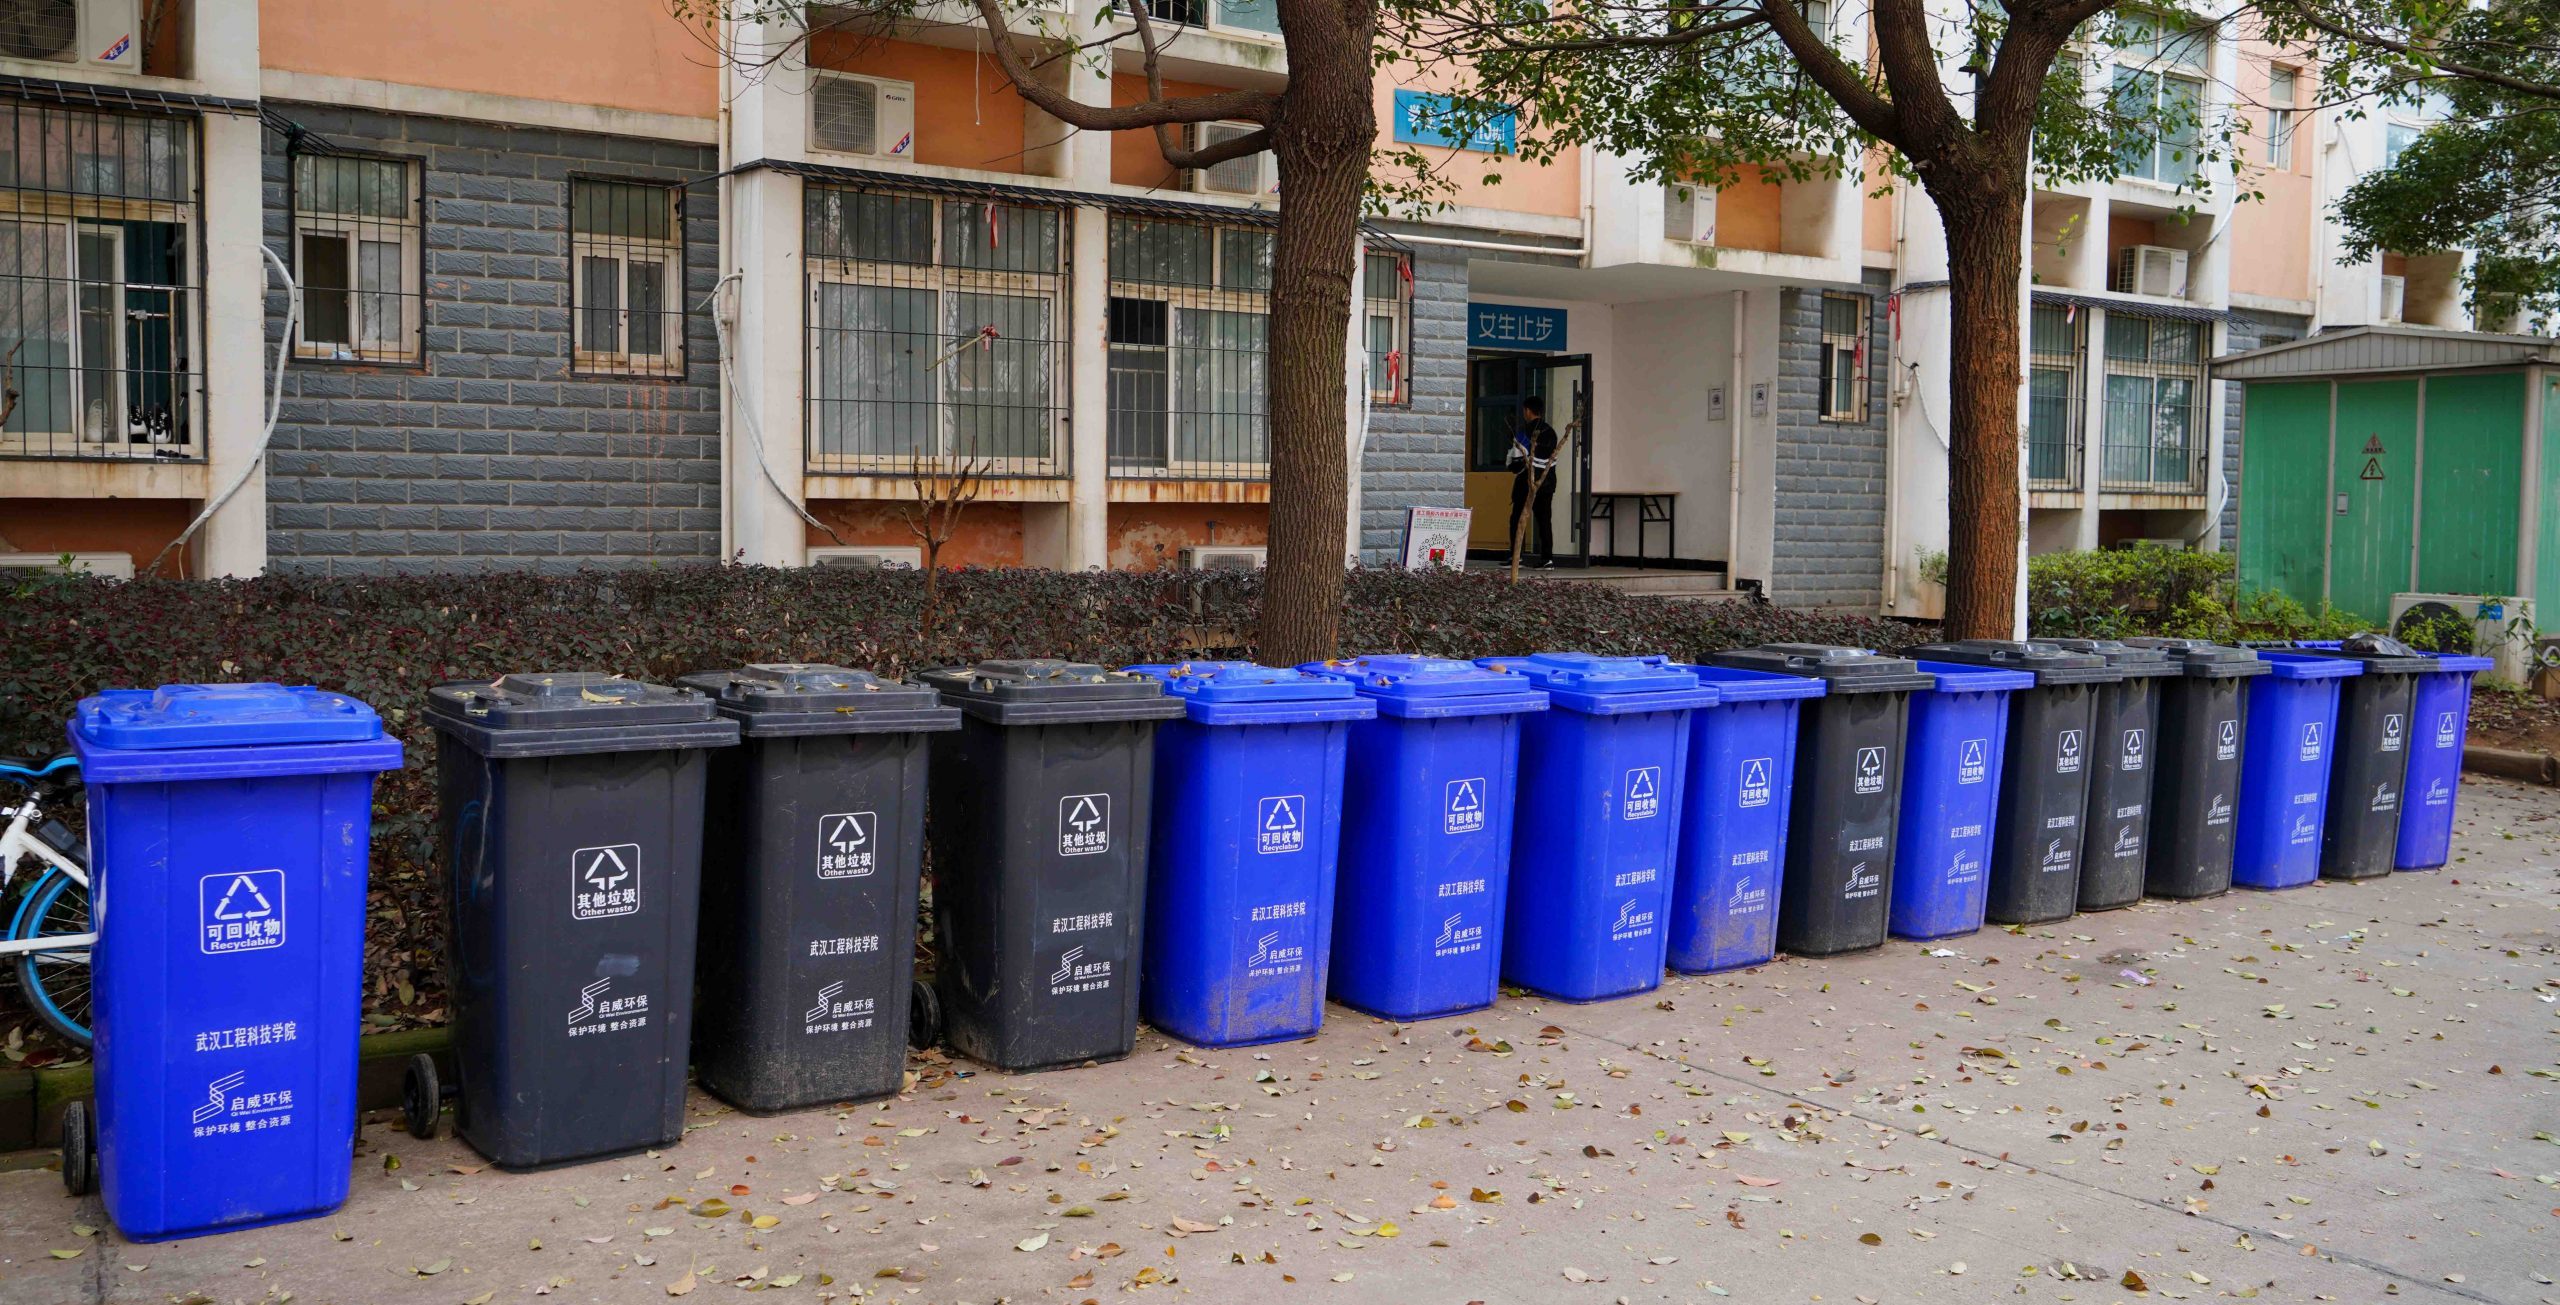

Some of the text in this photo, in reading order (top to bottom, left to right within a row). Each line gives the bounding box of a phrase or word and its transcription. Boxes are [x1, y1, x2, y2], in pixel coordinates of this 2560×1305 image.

[1478, 312, 1553, 341] 女生止步
[1627, 797, 1657, 812] 可回收物
[1447, 810, 1482, 826] 可回收物
[1449, 822, 1480, 831] Recyclable
[1062, 831, 1106, 848] 其他垃圾
[1261, 830, 1302, 845] 可回收物
[1064, 846, 1084, 854] Other
[1263, 844, 1299, 852] Recyclable
[821, 852, 872, 870] 其他垃圾
[824, 867, 869, 877] Other waste
[1615, 868, 1656, 887] 武汉工程科技学院
[1438, 878, 1485, 897] 武汉工程科技学院
[577, 888, 636, 910] 其他垃圾
[580, 904, 633, 917] Other waste
[1251, 900, 1306, 922] 武汉工程科技学院
[206, 919, 280, 942] 可回收物
[1052, 911, 1113, 934] 武汉工程科技学院
[210, 937, 277, 950] Recyclable
[809, 934, 879, 957] 武汉工程科技学院
[1269, 946, 1303, 960] 启威环保
[1074, 961, 1111, 976] 启威环保
[1051, 984, 1080, 996] 保护环境
[598, 994, 648, 1014] 启威环保
[832, 998, 875, 1014] 启威环保
[568, 1016, 647, 1037] 保护环境 整合资源
[805, 1018, 873, 1035] 保护环境 整合资源
[196, 1021, 297, 1052] 武汉工程科技学院
[231, 1090, 293, 1112] 启威环保
[193, 1115, 291, 1138] 保护环境 整合资源
